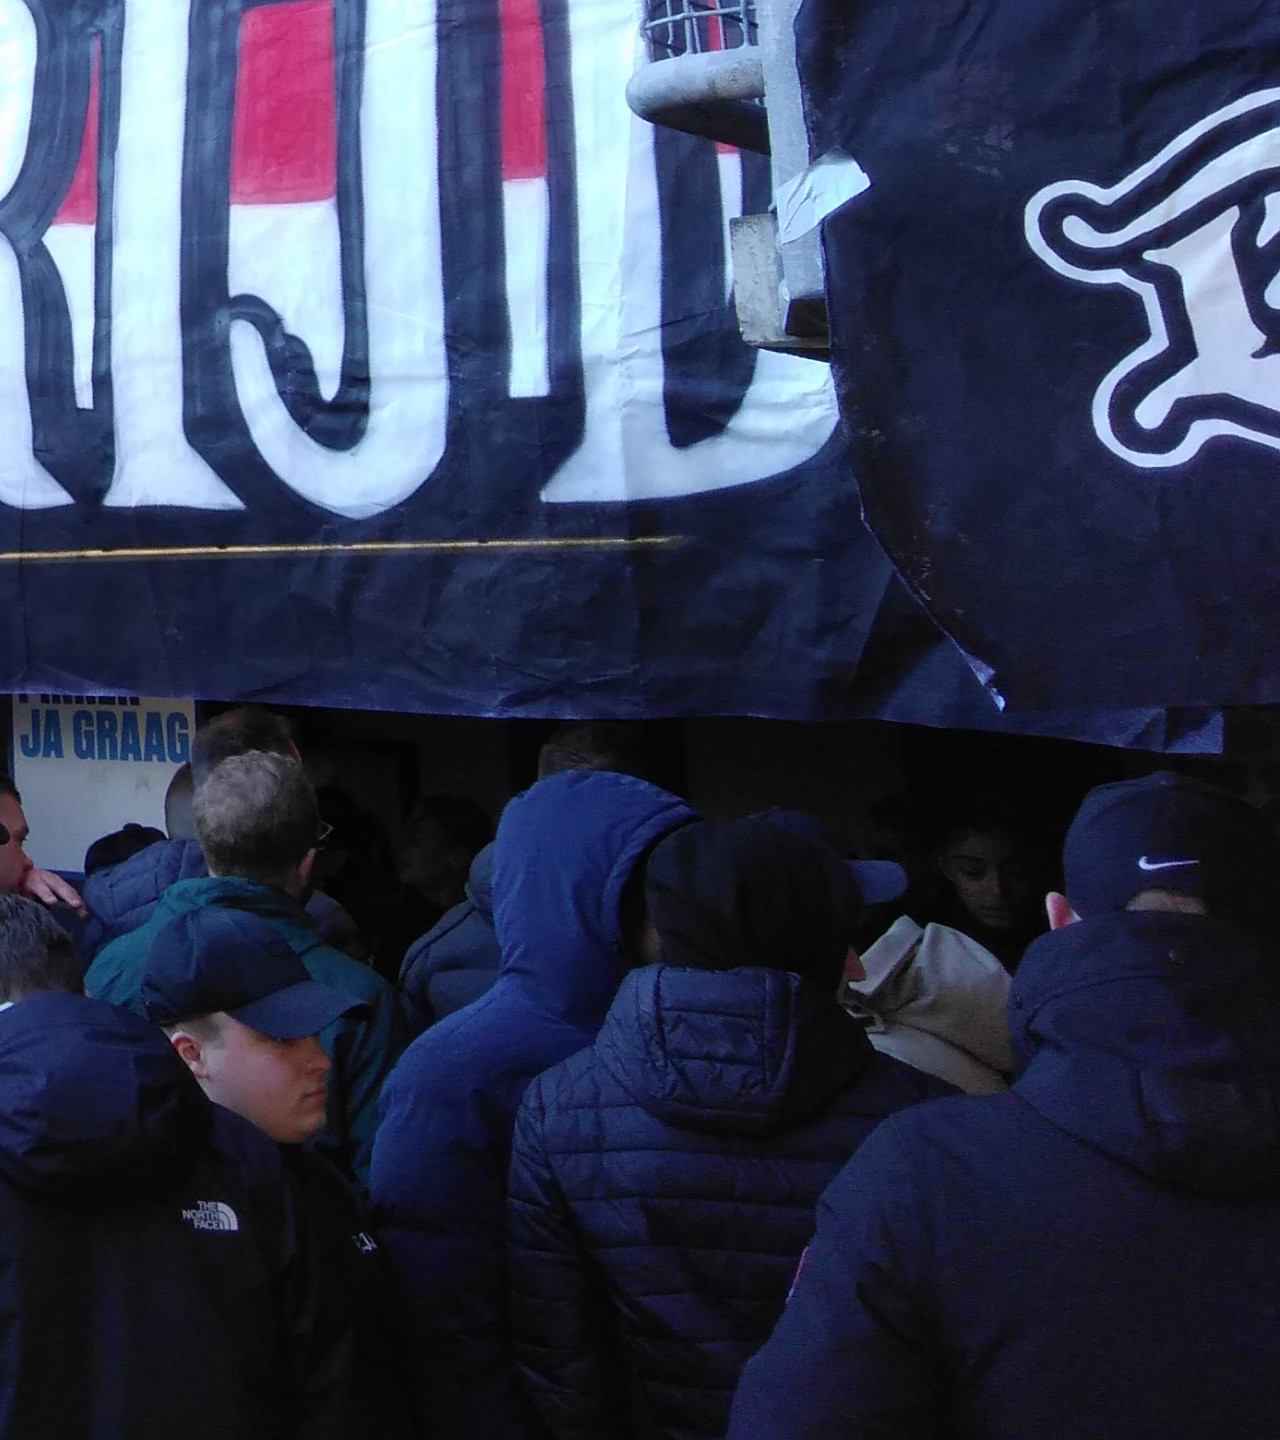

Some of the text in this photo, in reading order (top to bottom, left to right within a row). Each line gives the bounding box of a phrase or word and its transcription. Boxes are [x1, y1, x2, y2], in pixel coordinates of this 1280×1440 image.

[19, 708, 191, 764] JA GRAAG
[197, 1200, 217, 1211] THE
[182, 1209, 219, 1221] NORTH
[194, 1219, 221, 1231] FACE
